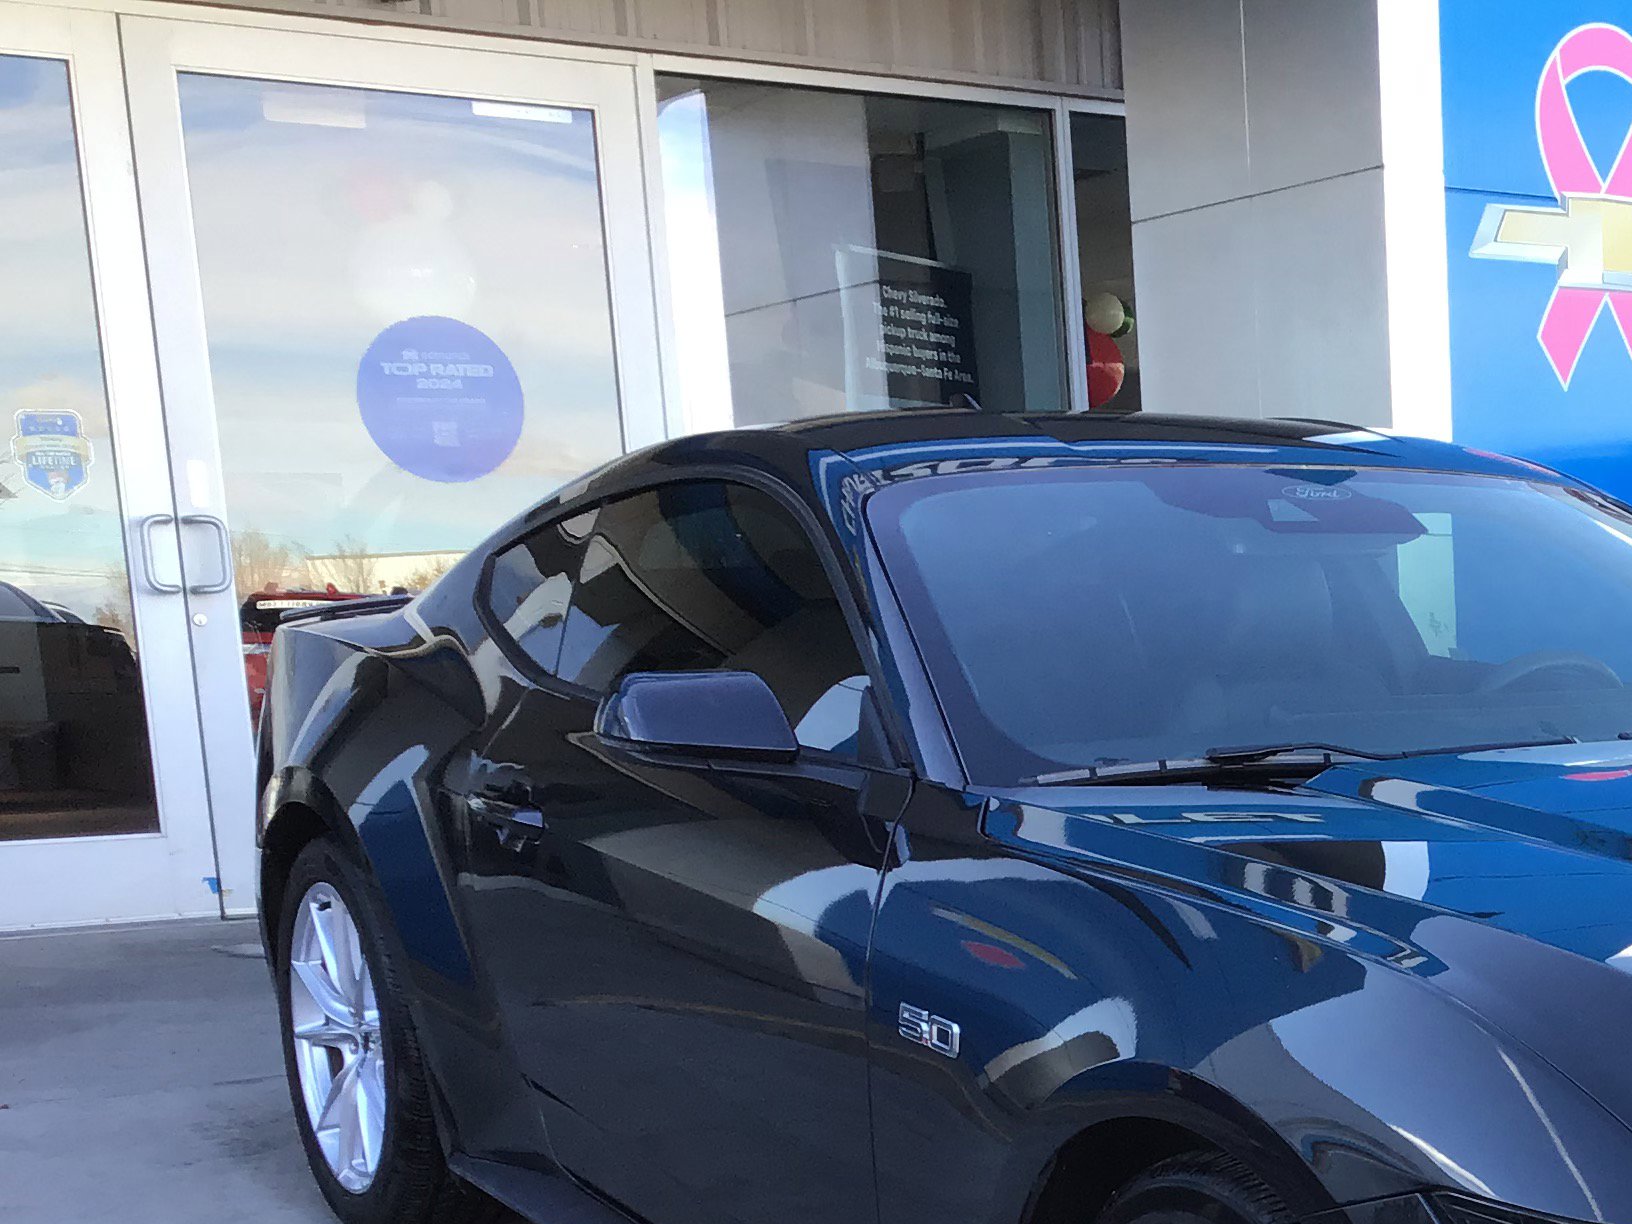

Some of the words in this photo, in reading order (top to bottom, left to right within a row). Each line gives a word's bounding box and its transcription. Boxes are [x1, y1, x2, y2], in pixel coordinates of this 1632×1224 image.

[882, 285, 907, 303] Chevy
[907, 327, 929, 341] truck
[380, 361, 428, 376] TOP
[429, 363, 494, 378] RATED
[416, 377, 463, 389] 2024
[1296, 487, 1339, 498] Ford
